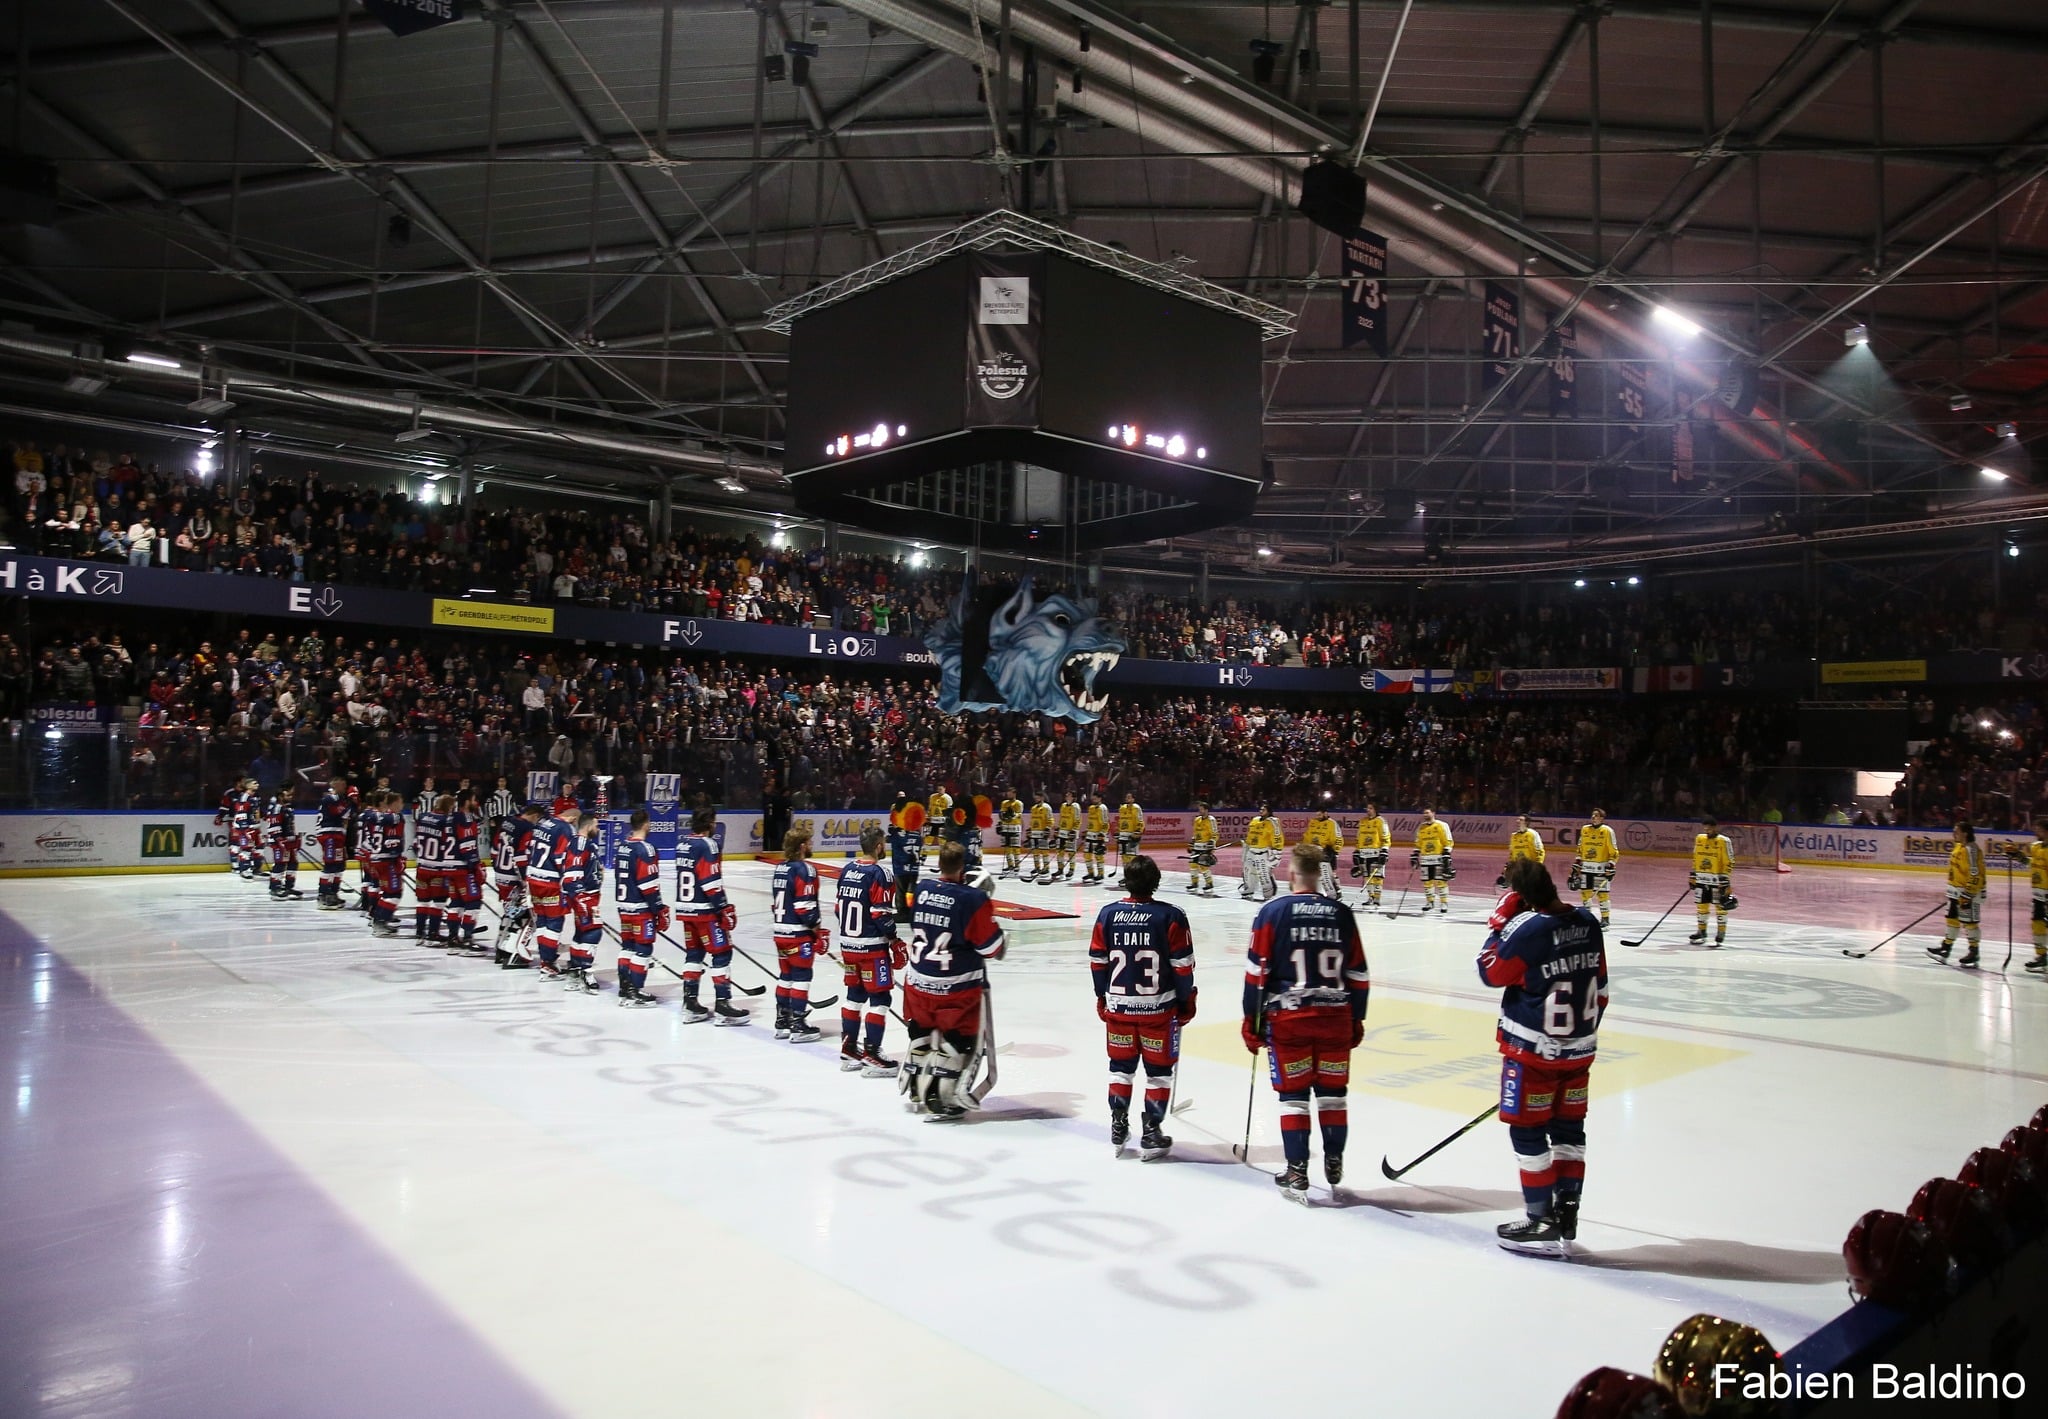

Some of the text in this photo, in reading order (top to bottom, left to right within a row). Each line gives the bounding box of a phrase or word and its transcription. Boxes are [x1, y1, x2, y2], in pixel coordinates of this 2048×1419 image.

[1493, 323, 1511, 358] 71
[977, 364, 1029, 376] Polesud
[26, 569, 45, 591] à
[56, 566, 88, 595] K
[289, 587, 312, 612] E
[663, 620, 680, 642] F
[809, 634, 860, 656] L à O
[1218, 668, 1235, 685] H
[1721, 667, 1735, 687] J
[2002, 657, 2024, 678] K
[44, 840, 95, 848] COMPTOIR
[1779, 832, 1878, 859] MédiAlpes
[838, 898, 863, 938] 10
[1112, 910, 1153, 924] VAUJANY
[1113, 932, 1151, 946] F. DAIR
[1289, 926, 1343, 943] PASCAL
[879, 966, 889, 983] CAR
[1108, 950, 1160, 995] 23
[1290, 949, 1346, 992] 19
[1543, 975, 1600, 1037] 64
[1502, 1079, 1516, 1108] CAR
